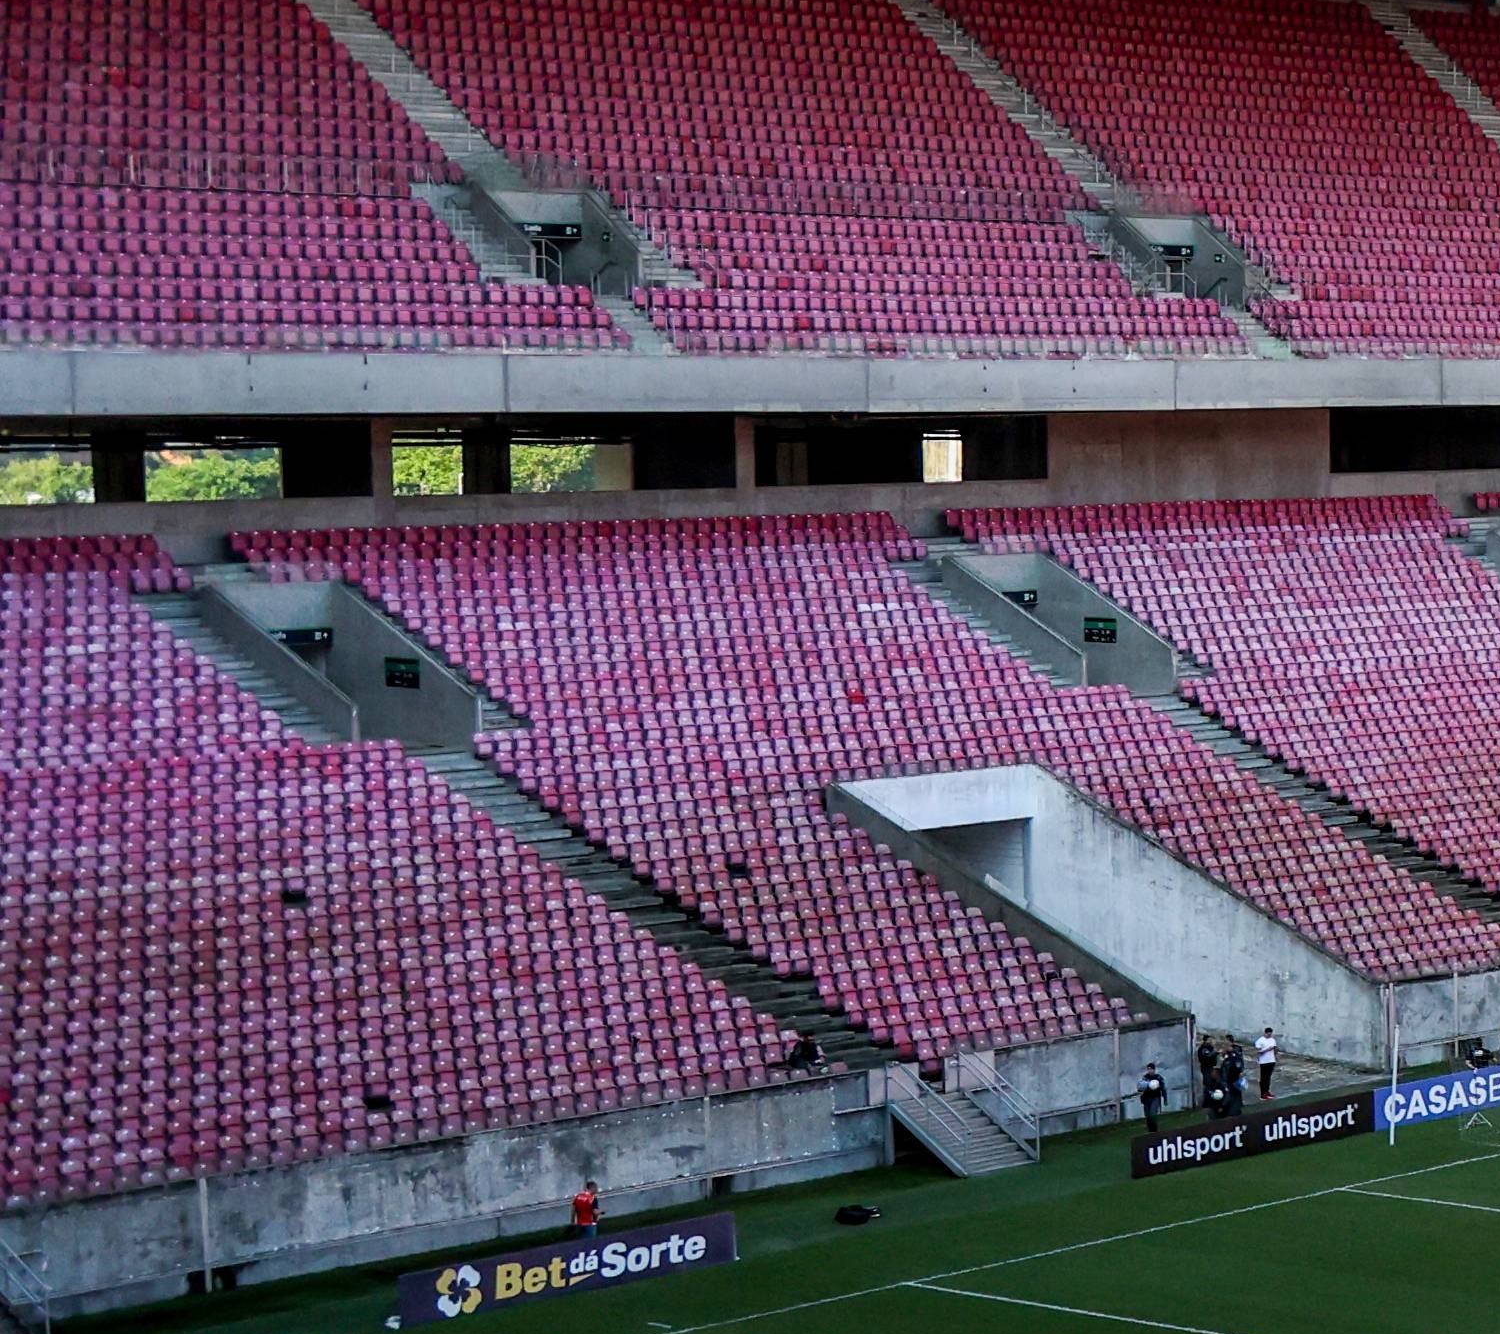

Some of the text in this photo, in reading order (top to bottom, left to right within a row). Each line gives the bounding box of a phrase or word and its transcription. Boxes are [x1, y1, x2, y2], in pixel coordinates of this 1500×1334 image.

[1148, 1104, 1356, 1164] uhlsport uhlsport
[496, 1232, 707, 1300] Bet dá Sorte
